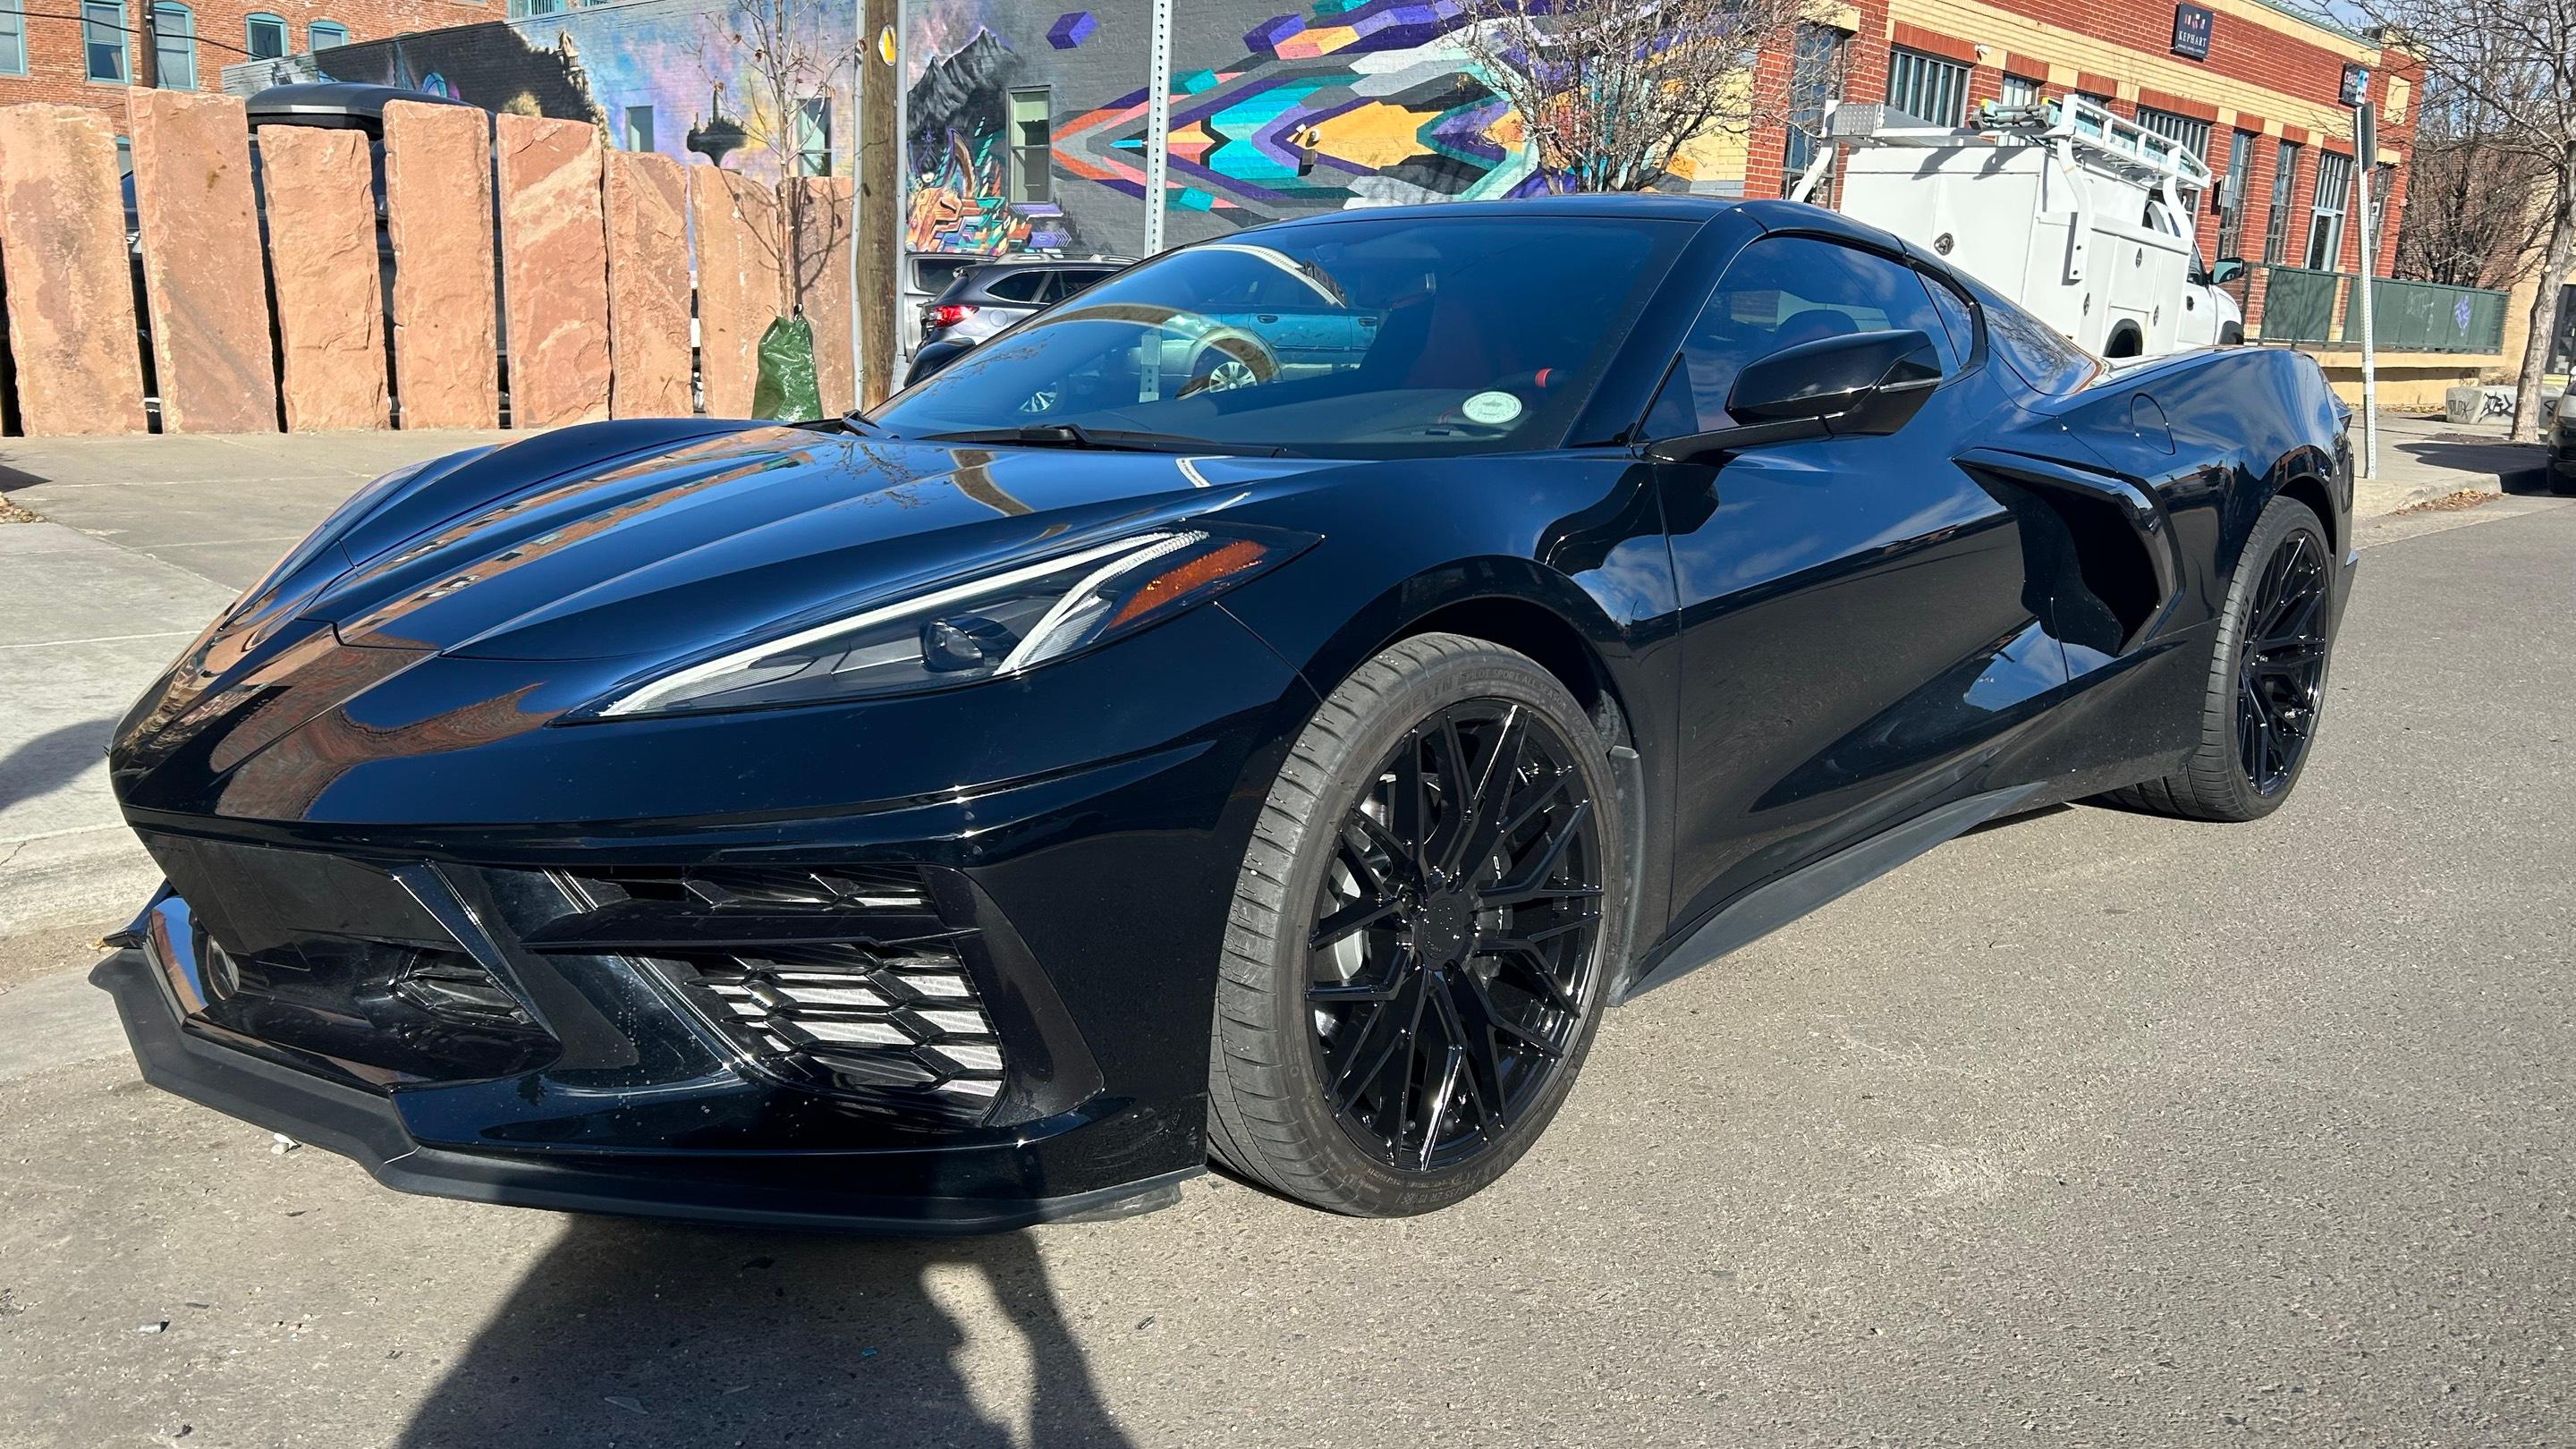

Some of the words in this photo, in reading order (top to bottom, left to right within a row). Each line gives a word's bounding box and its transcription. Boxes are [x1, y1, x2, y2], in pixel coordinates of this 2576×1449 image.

[2178, 30, 2207, 47] KEPHART
[1466, 671, 1489, 681] PILOT
[1493, 669, 1520, 681] SPORT
[1522, 675, 1537, 688] ALL
[1538, 683, 1568, 710] SEASON
